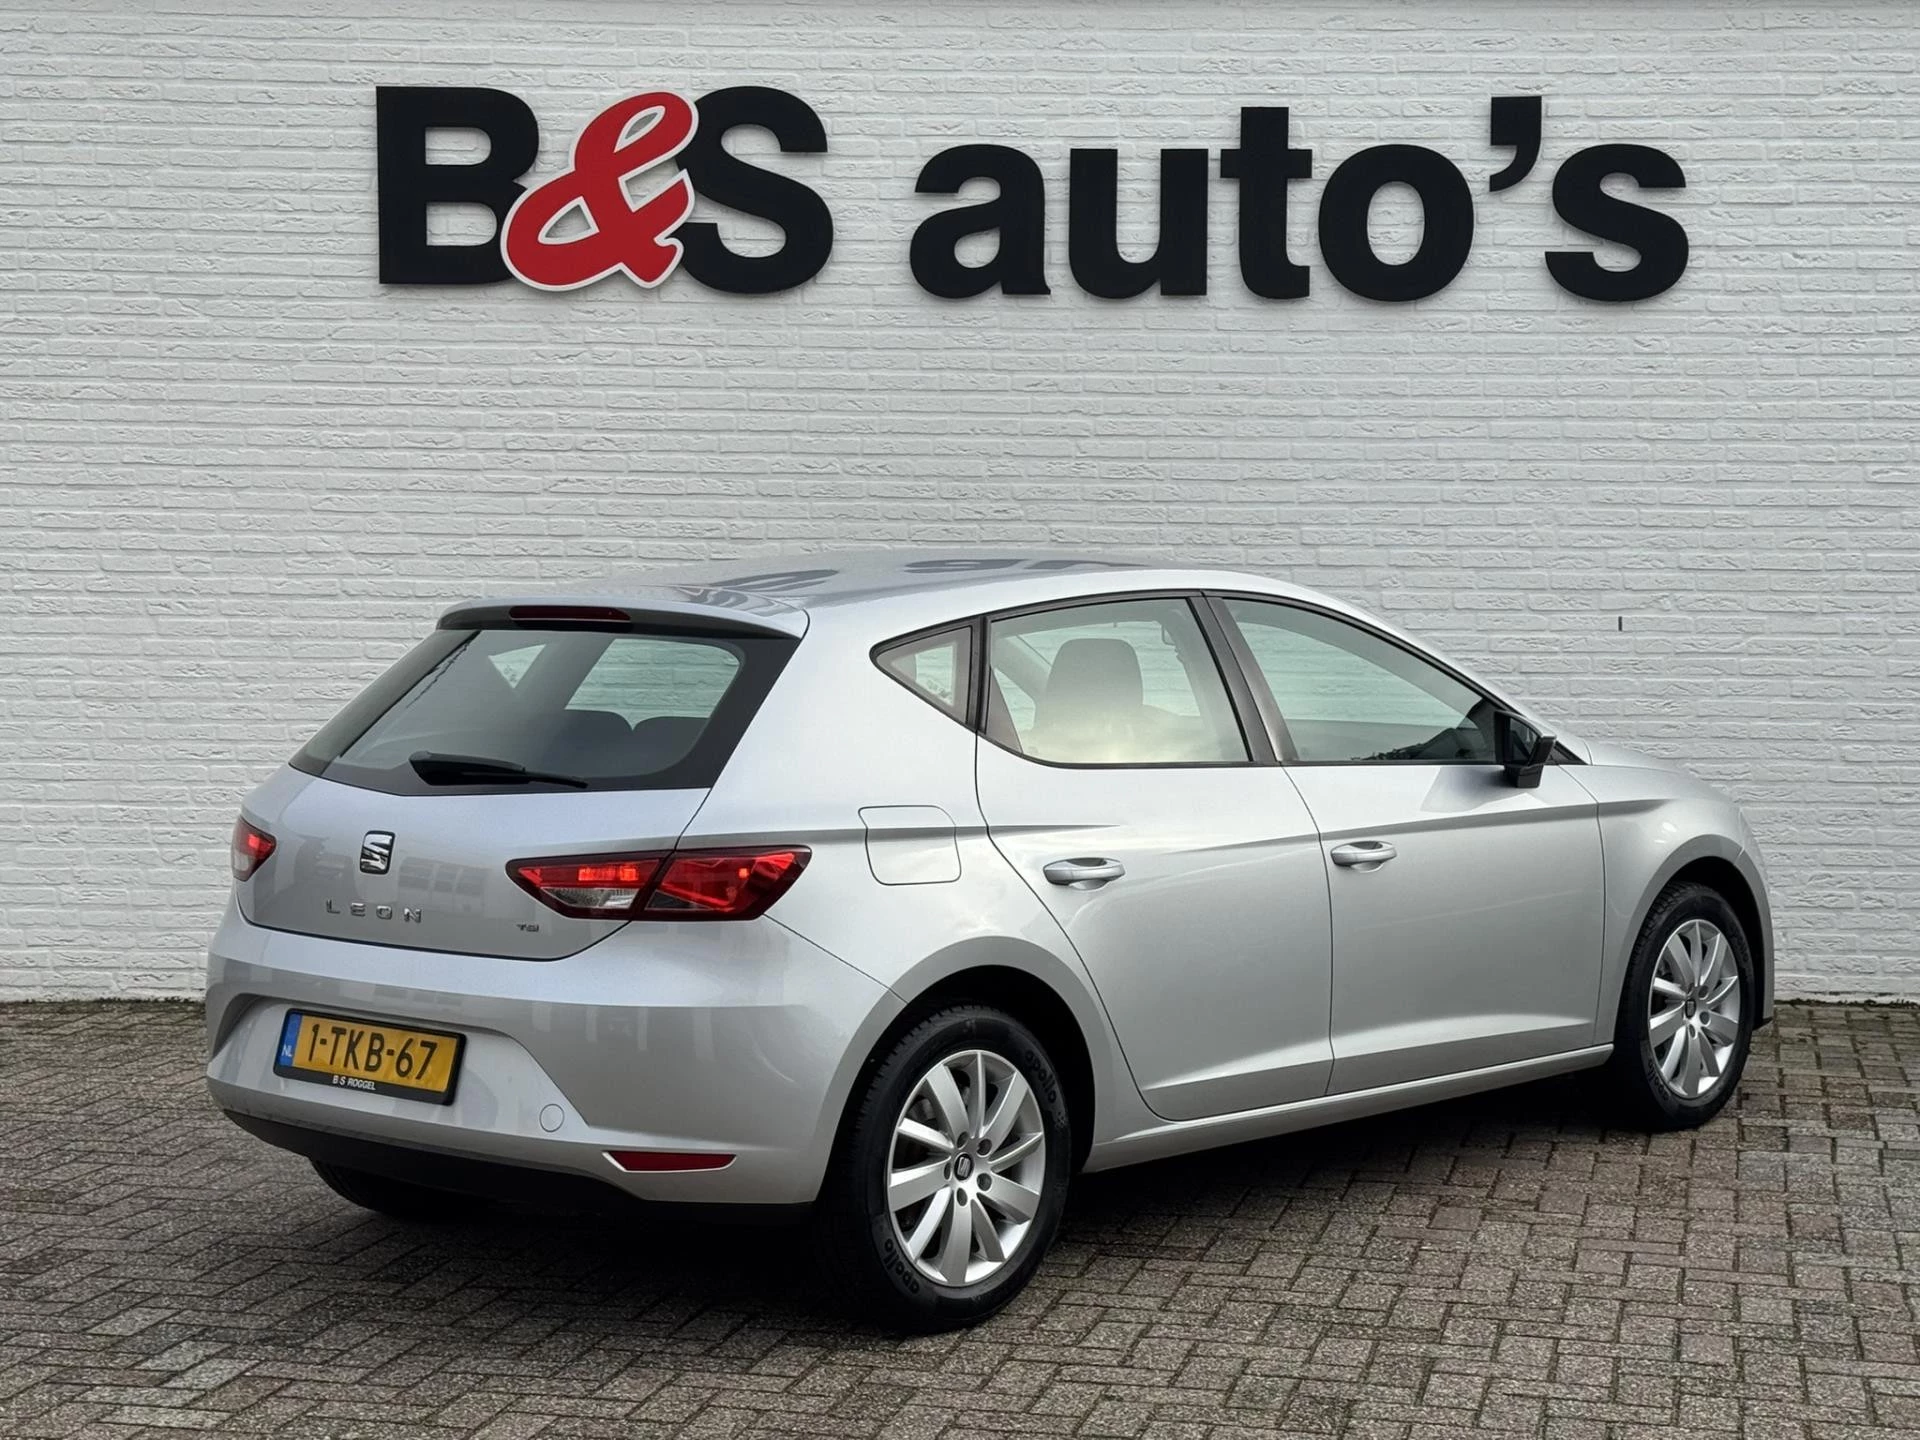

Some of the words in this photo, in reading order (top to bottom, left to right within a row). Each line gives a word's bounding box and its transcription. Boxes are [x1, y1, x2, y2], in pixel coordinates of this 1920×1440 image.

[374, 85, 835, 296] B&S
[908, 94, 1690, 304] auto's
[326, 899, 422, 923] LEON
[282, 1044, 292, 1058] NL
[308, 1023, 437, 1080] 1-TKB-67
[1025, 1049, 1057, 1104] apollo
[884, 1238, 920, 1294] apollo
